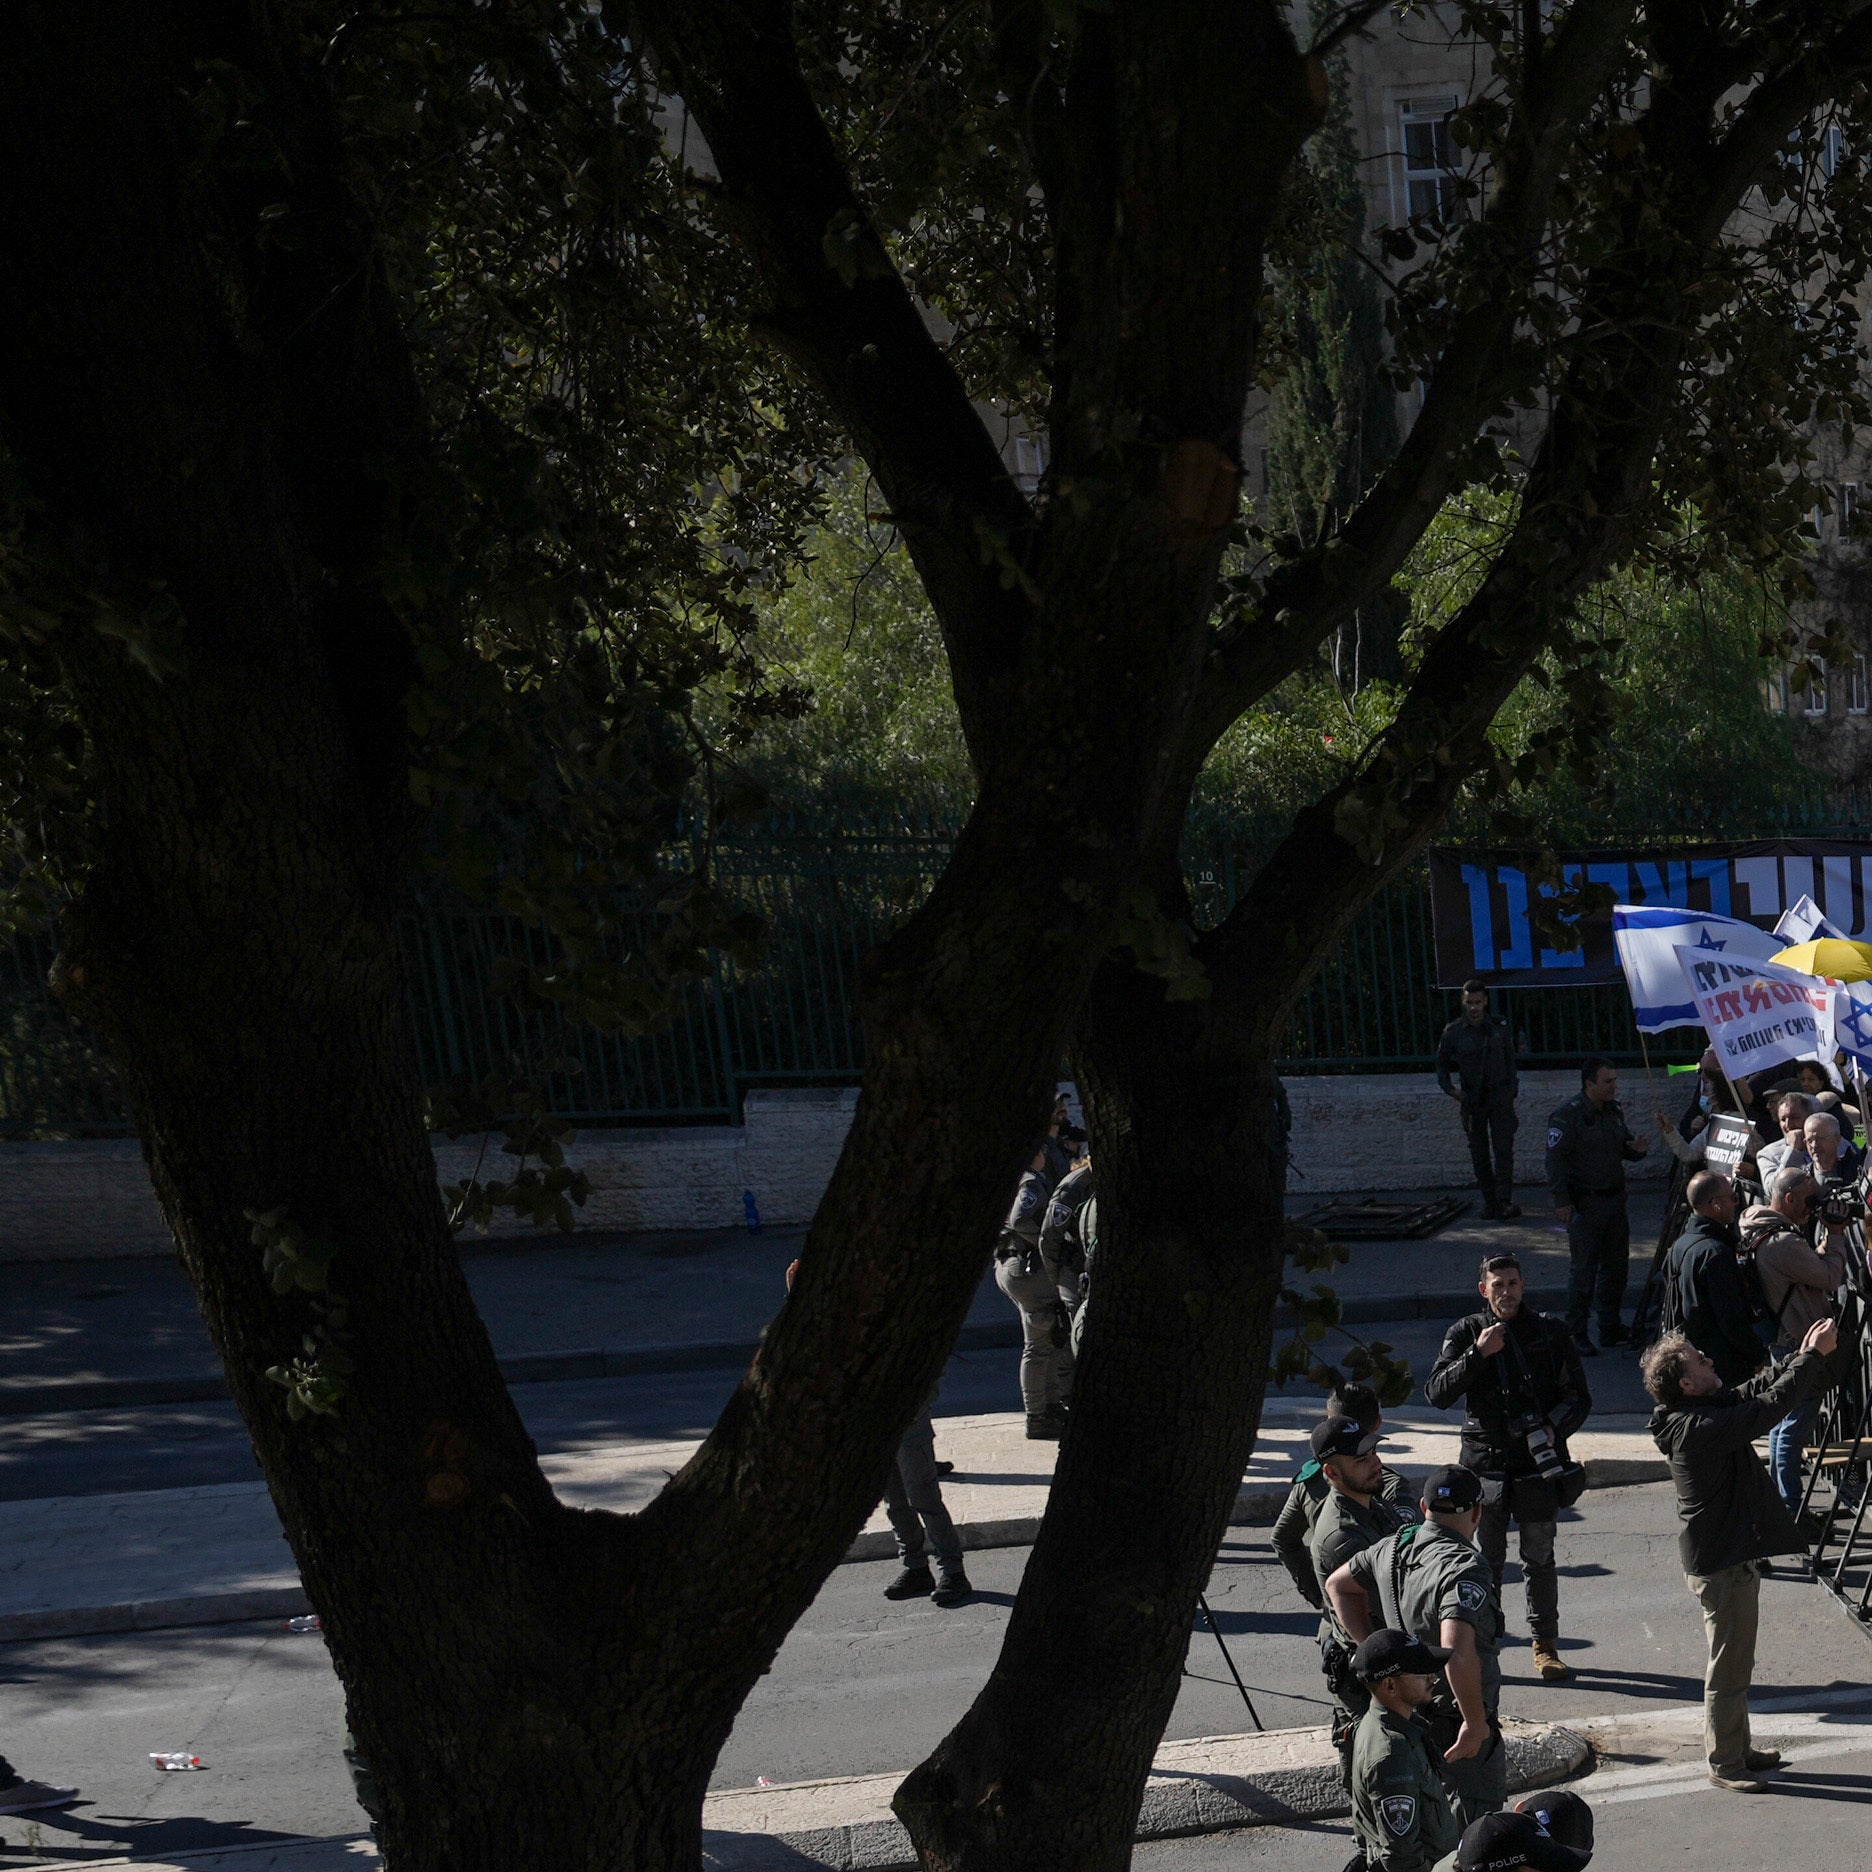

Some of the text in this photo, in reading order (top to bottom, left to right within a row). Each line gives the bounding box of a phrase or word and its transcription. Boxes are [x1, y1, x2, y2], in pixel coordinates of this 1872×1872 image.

[1315, 1441, 1333, 1455] POLICE
[1372, 1663, 1402, 1681] POLICE
[1487, 1852, 1528, 1872] POLICE
